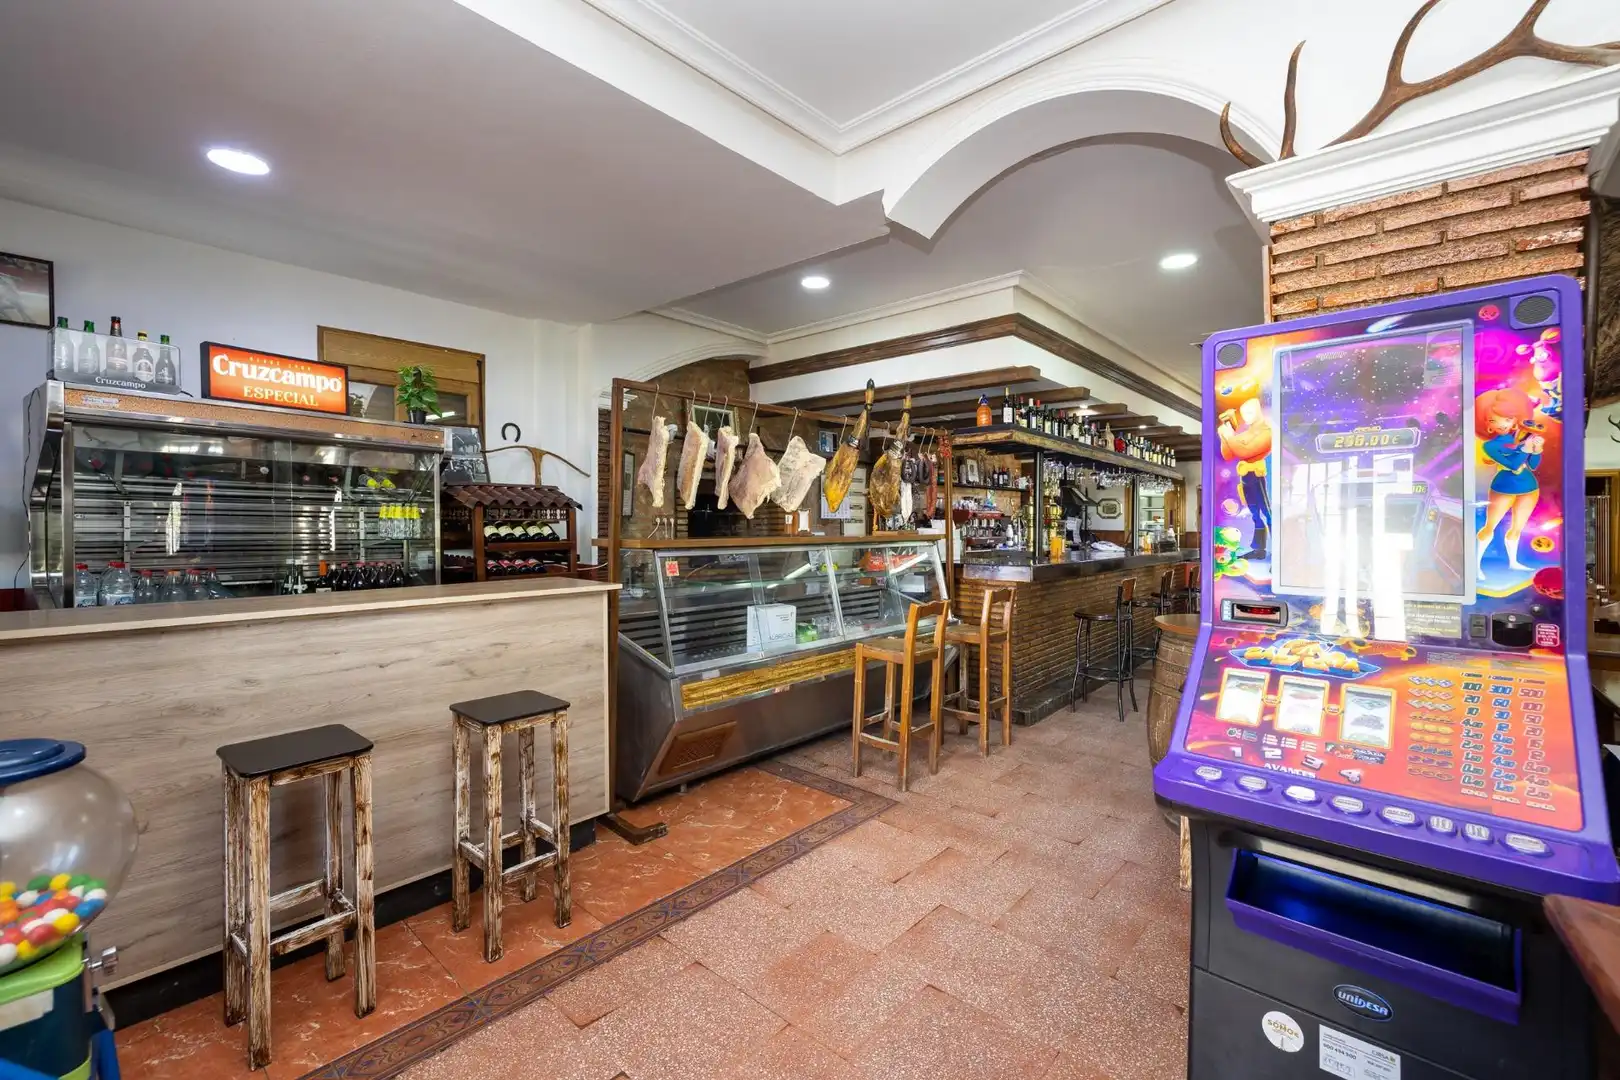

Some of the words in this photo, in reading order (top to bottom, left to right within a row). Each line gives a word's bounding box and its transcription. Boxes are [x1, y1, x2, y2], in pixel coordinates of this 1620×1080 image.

[213, 354, 342, 393] Cruzcampo
[95, 376, 147, 389] Cruzcampo
[243, 385, 319, 407] ESPECIAL
[1490, 685, 1512, 694] 300
[1520, 688, 1544, 698] 500
[1464, 694, 1480, 703] 20
[1493, 698, 1510, 707] 60
[1466, 707, 1479, 716] 10
[1495, 710, 1510, 719] 30
[1526, 714, 1542, 724] 50
[1462, 718, 1483, 728] 4.00
[1462, 729, 1483, 739] 3.20
[1230, 746, 1242, 757] 1
[1262, 746, 1282, 759] 2
[1301, 754, 1323, 770] 3
[1264, 762, 1316, 778] AVANCES
[1338, 769, 1362, 784] 4
